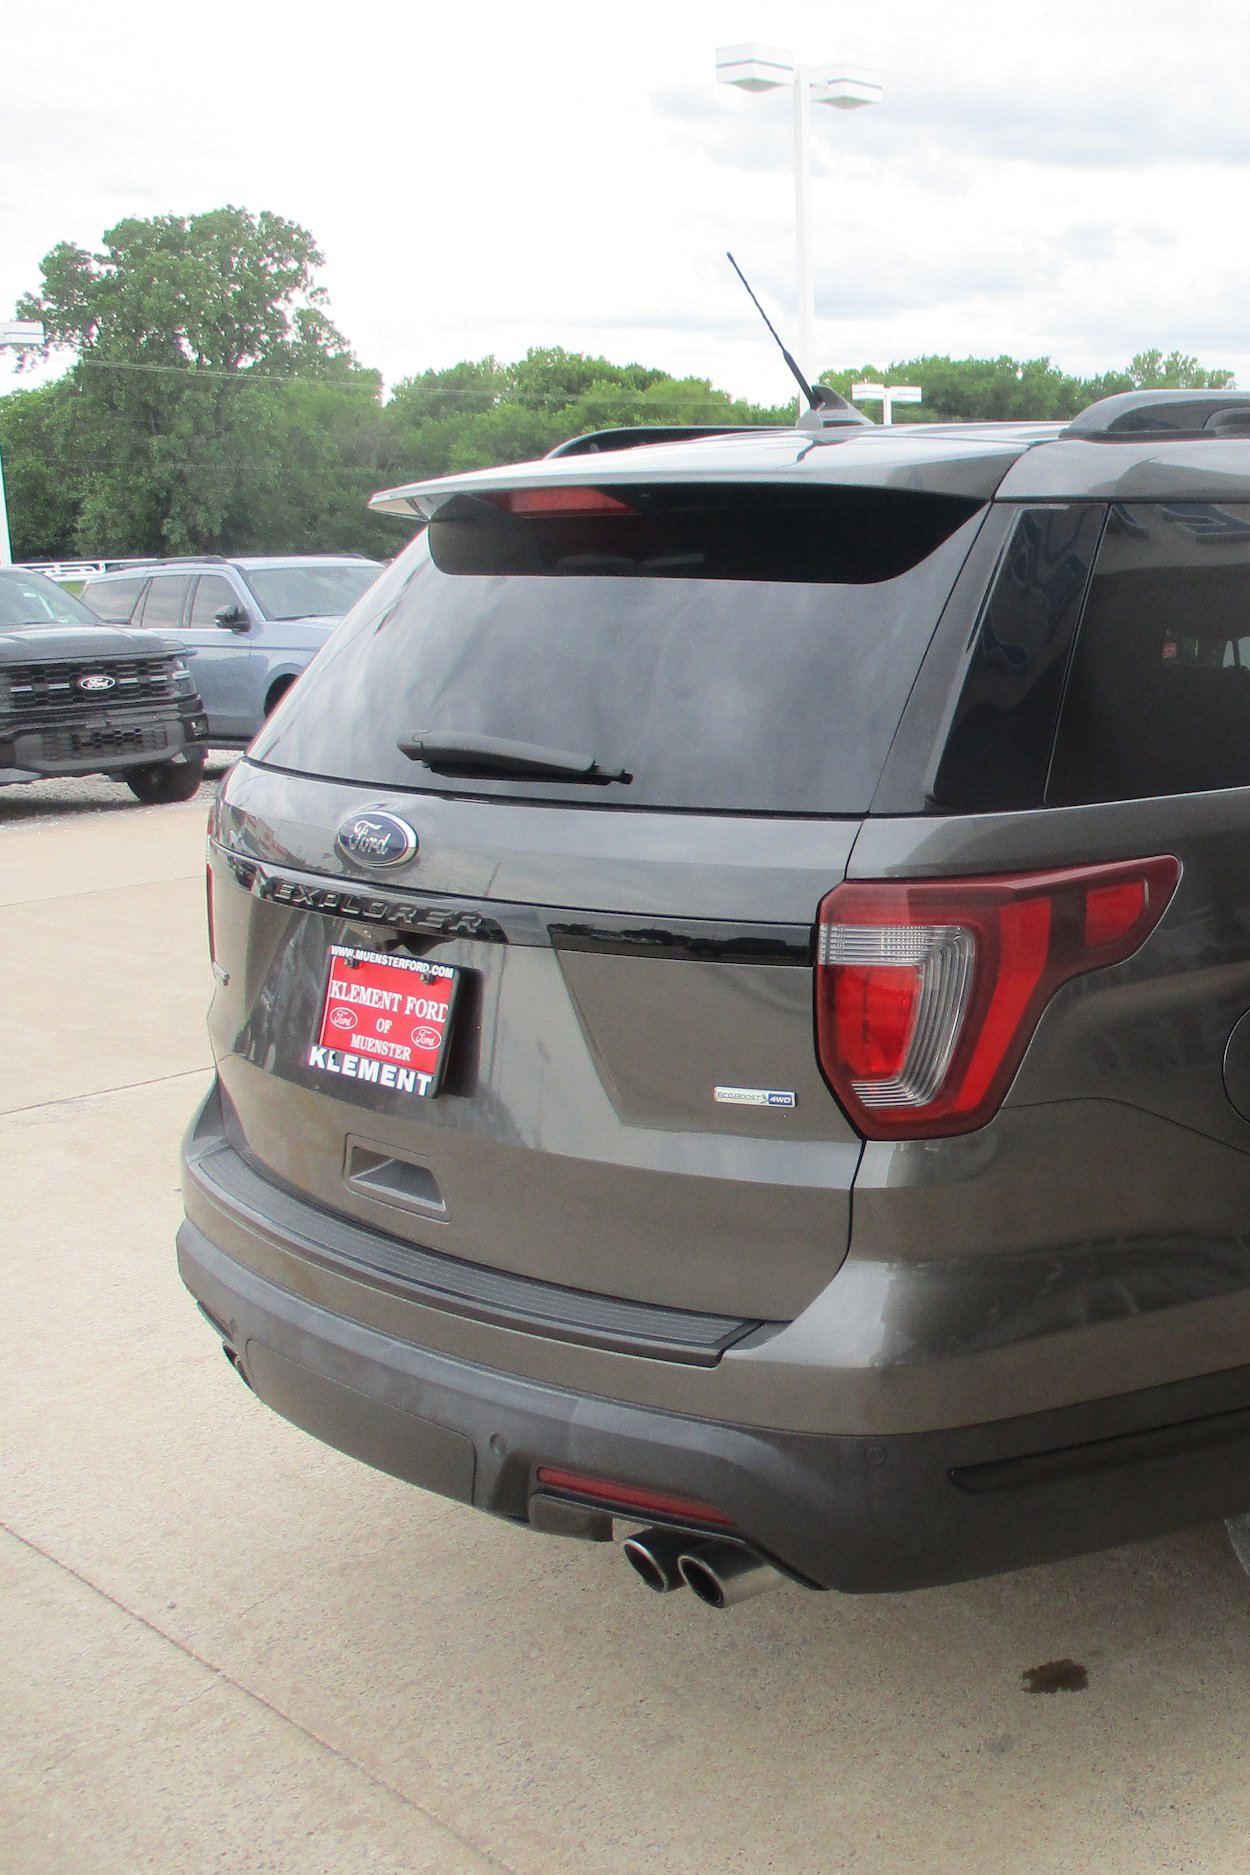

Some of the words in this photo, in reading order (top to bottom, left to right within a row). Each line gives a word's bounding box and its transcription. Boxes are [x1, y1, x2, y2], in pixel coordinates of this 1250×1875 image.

[349, 819, 392, 856] Ford
[275, 883, 482, 932] EXPLORER
[330, 944, 455, 979] WWW.MUENSTERFORD.COM
[330, 980, 403, 1013] KLEMENT
[404, 996, 449, 1023] FORD
[332, 1009, 355, 1028] Ford
[375, 1018, 393, 1034] OF
[350, 1033, 412, 1062] MUENSTER
[414, 1027, 438, 1047] Ford
[308, 1045, 433, 1097] KLEMENT
[770, 1095, 791, 1104] 4WD
